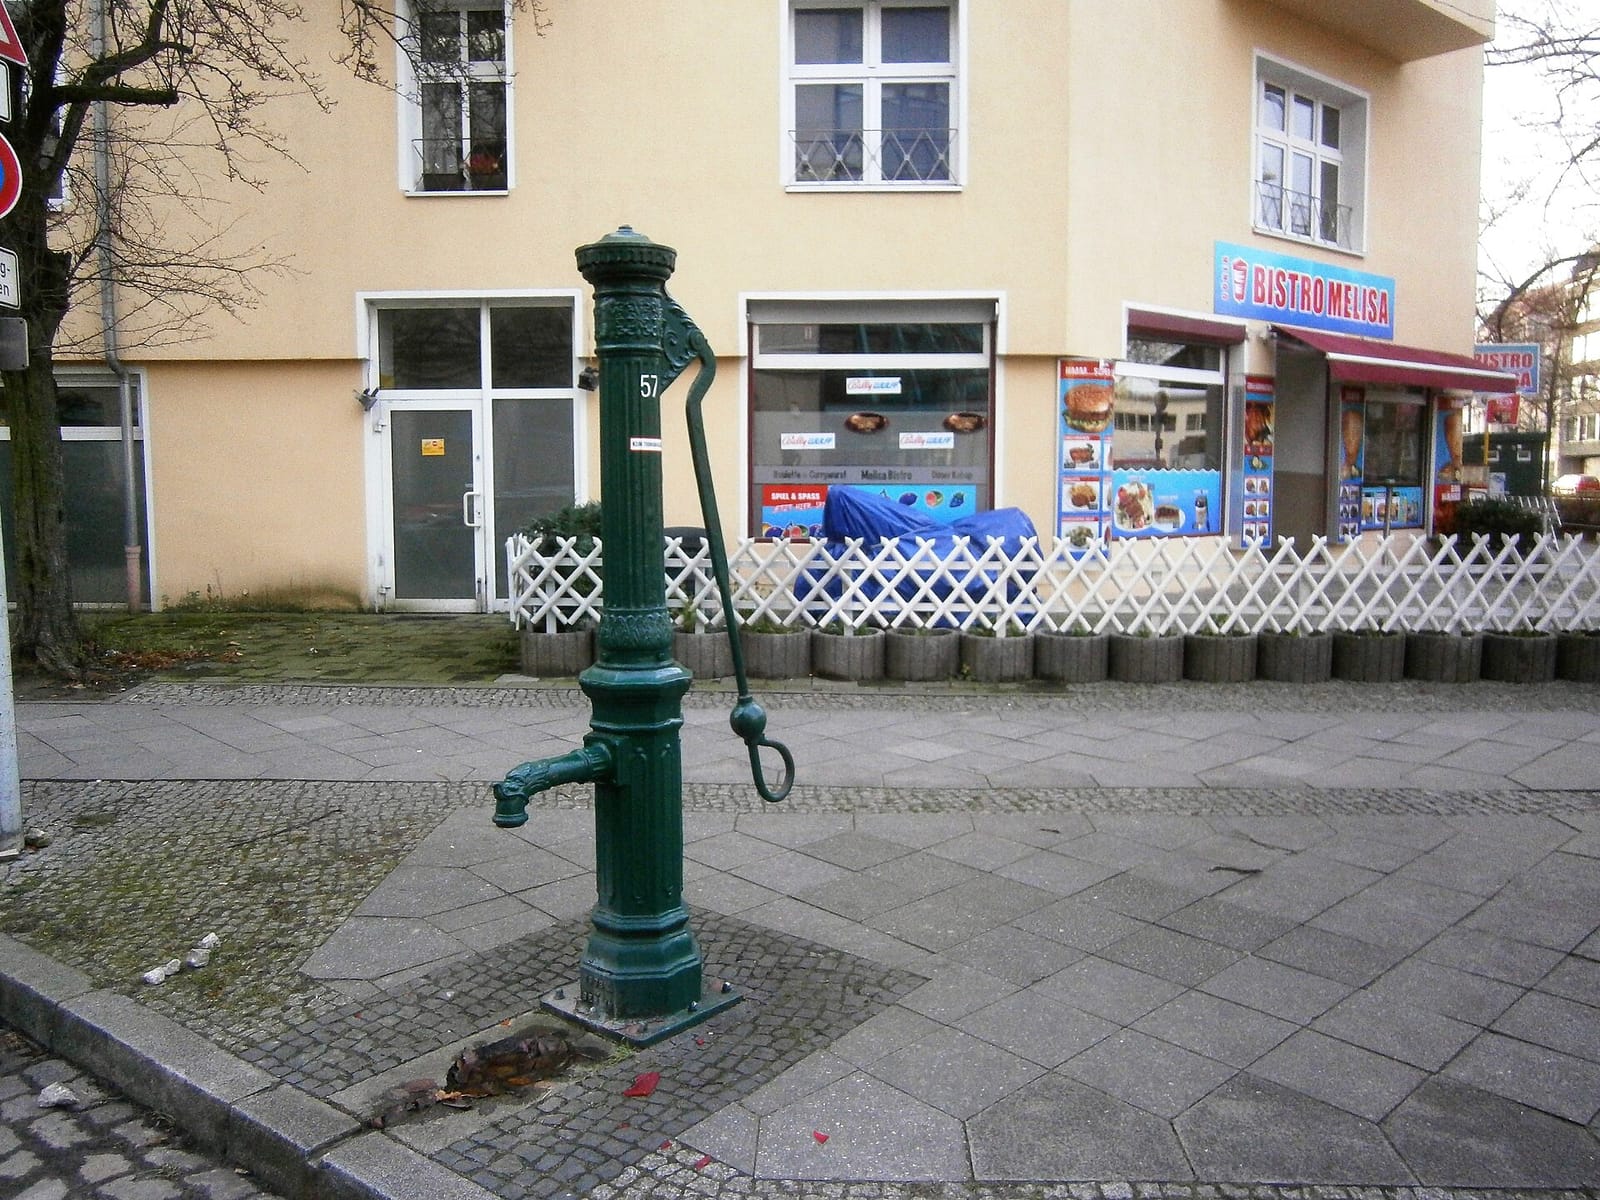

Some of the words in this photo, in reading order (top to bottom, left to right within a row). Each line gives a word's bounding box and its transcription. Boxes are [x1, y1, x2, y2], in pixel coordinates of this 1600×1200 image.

[1253, 266, 1324, 314] BISTRO
[1327, 281, 1389, 325] MELISA
[640, 374, 658, 398] 57
[888, 469, 913, 480] Bistro
[771, 492, 790, 500] SPIEL
[797, 492, 820, 500] SPASS
